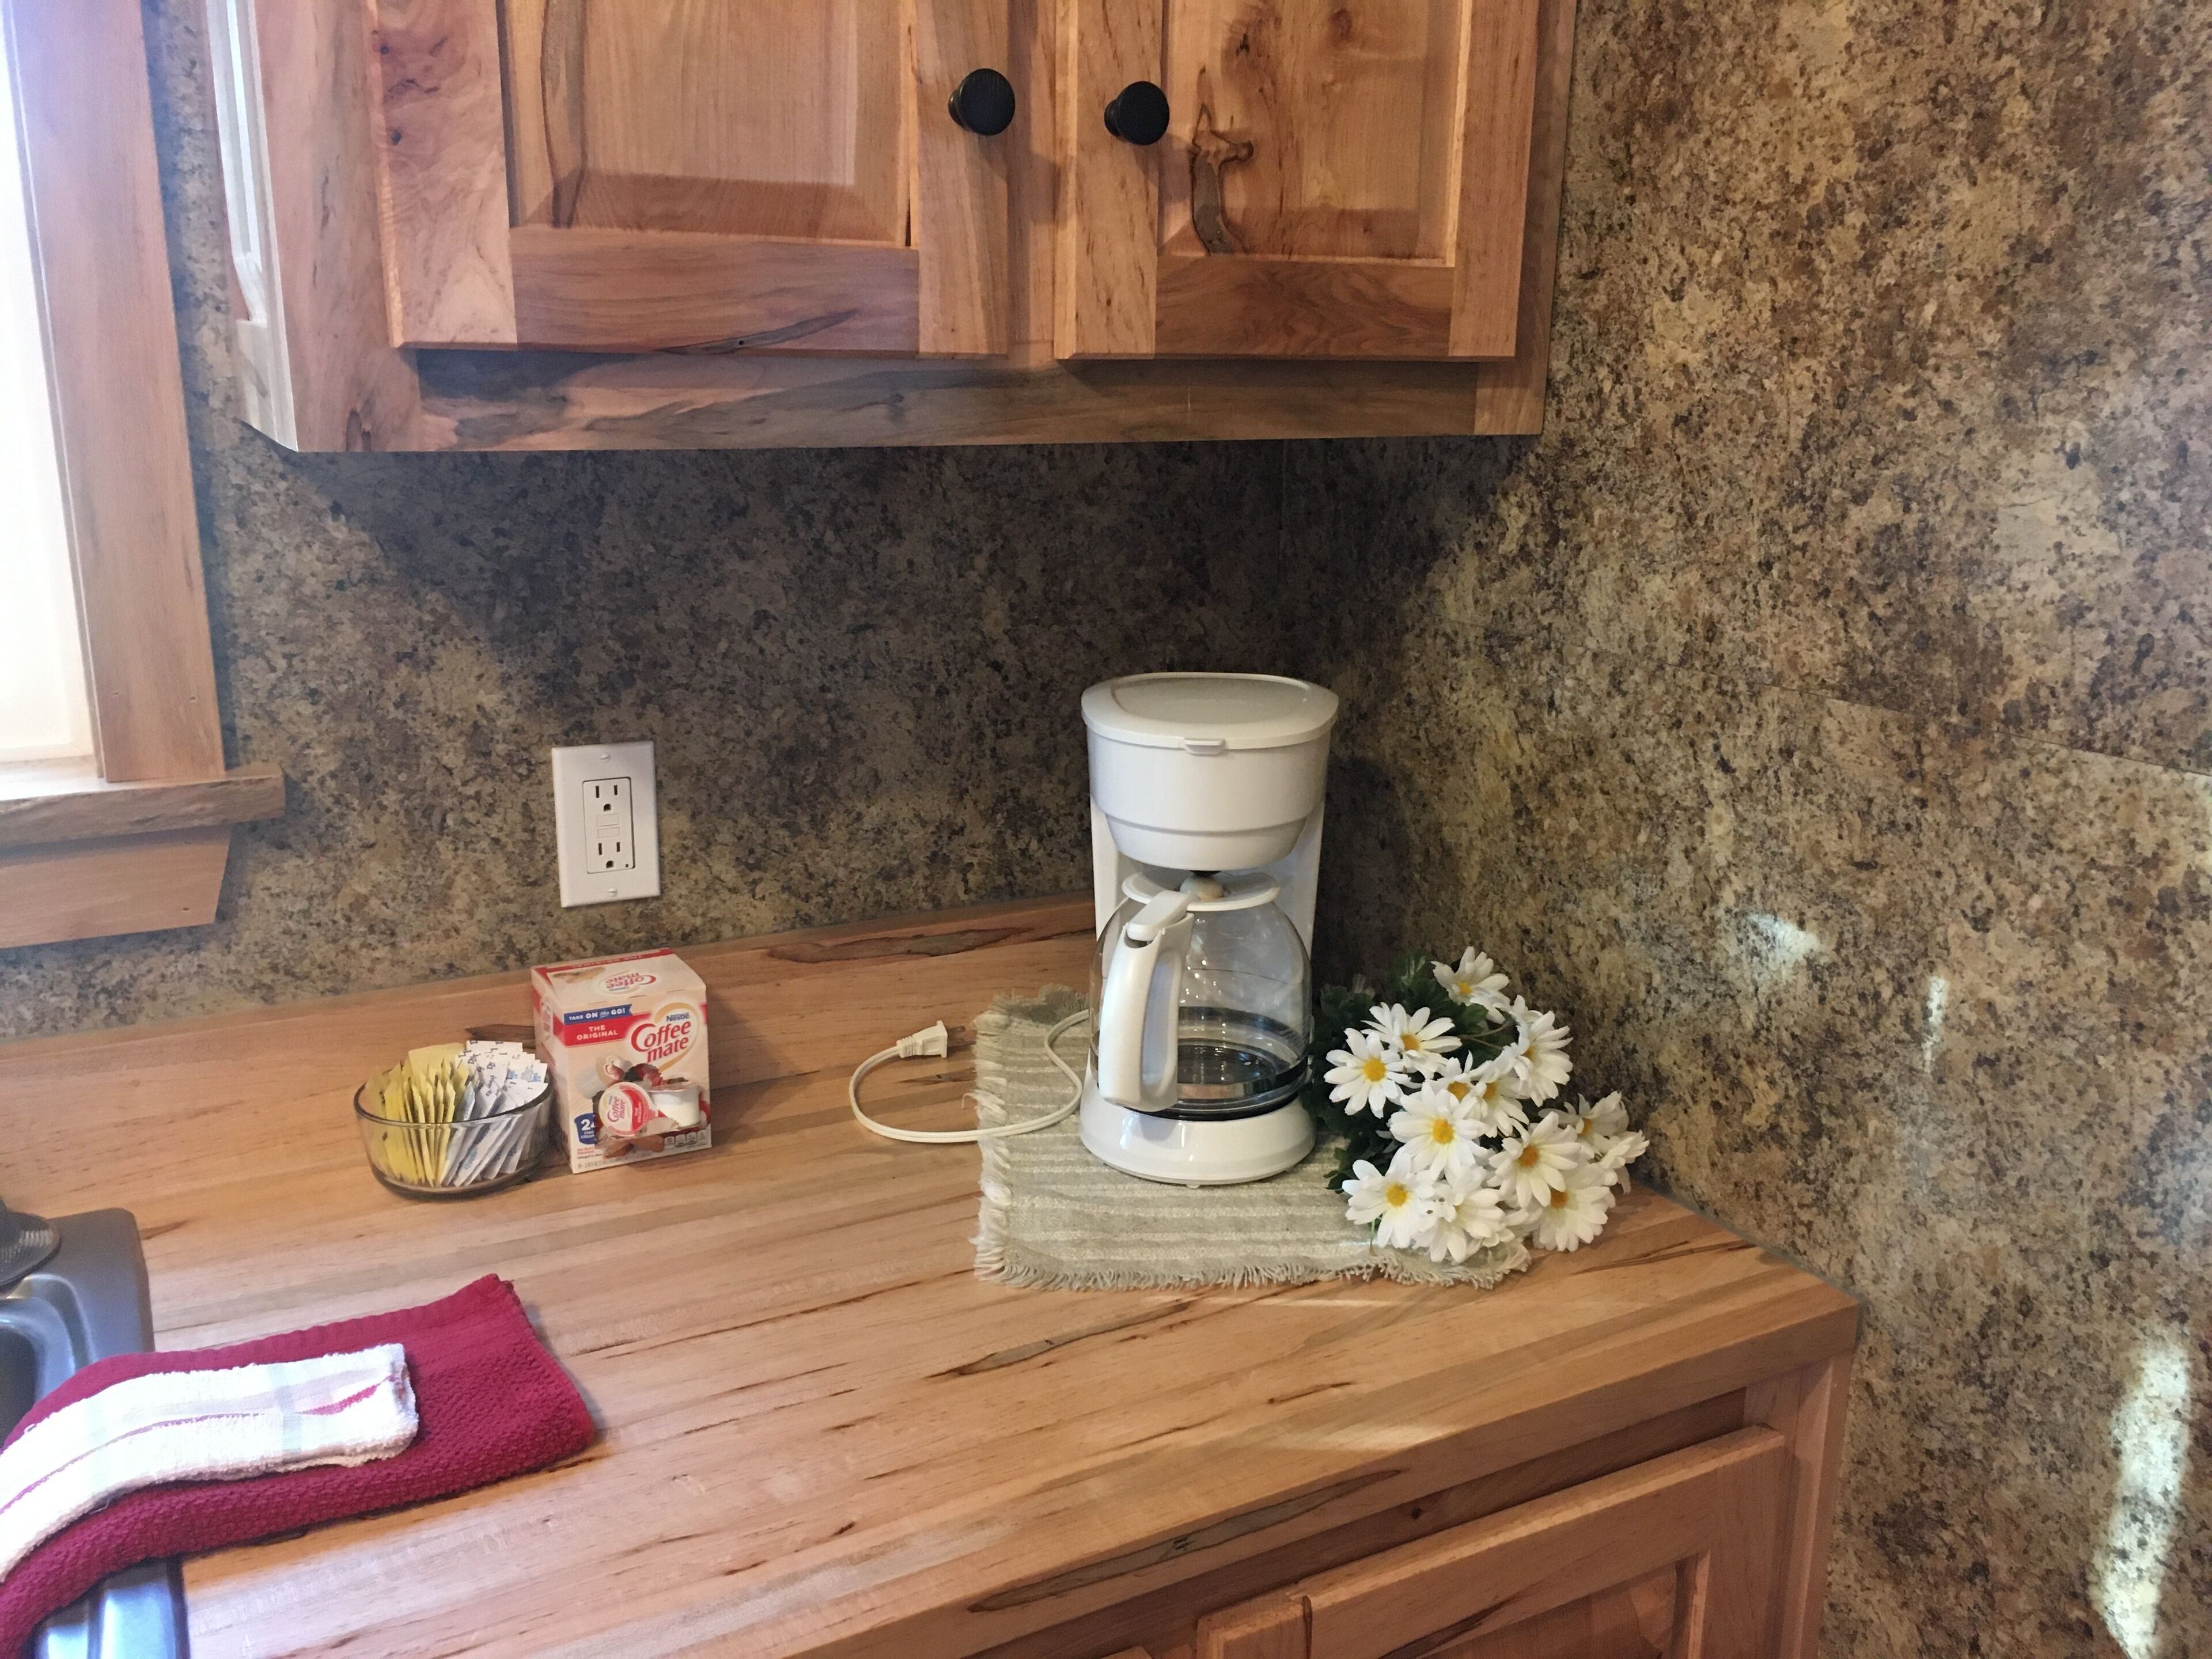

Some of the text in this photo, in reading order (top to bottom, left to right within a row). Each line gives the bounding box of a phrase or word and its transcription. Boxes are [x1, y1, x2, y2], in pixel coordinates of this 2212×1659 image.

[611, 1007, 626, 1016] GO!
[577, 1029, 619, 1040] ORIGINAL
[631, 1021, 691, 1052] Coffee
[647, 1037, 689, 1063] mate
[607, 1096, 620, 1122] Coffee
